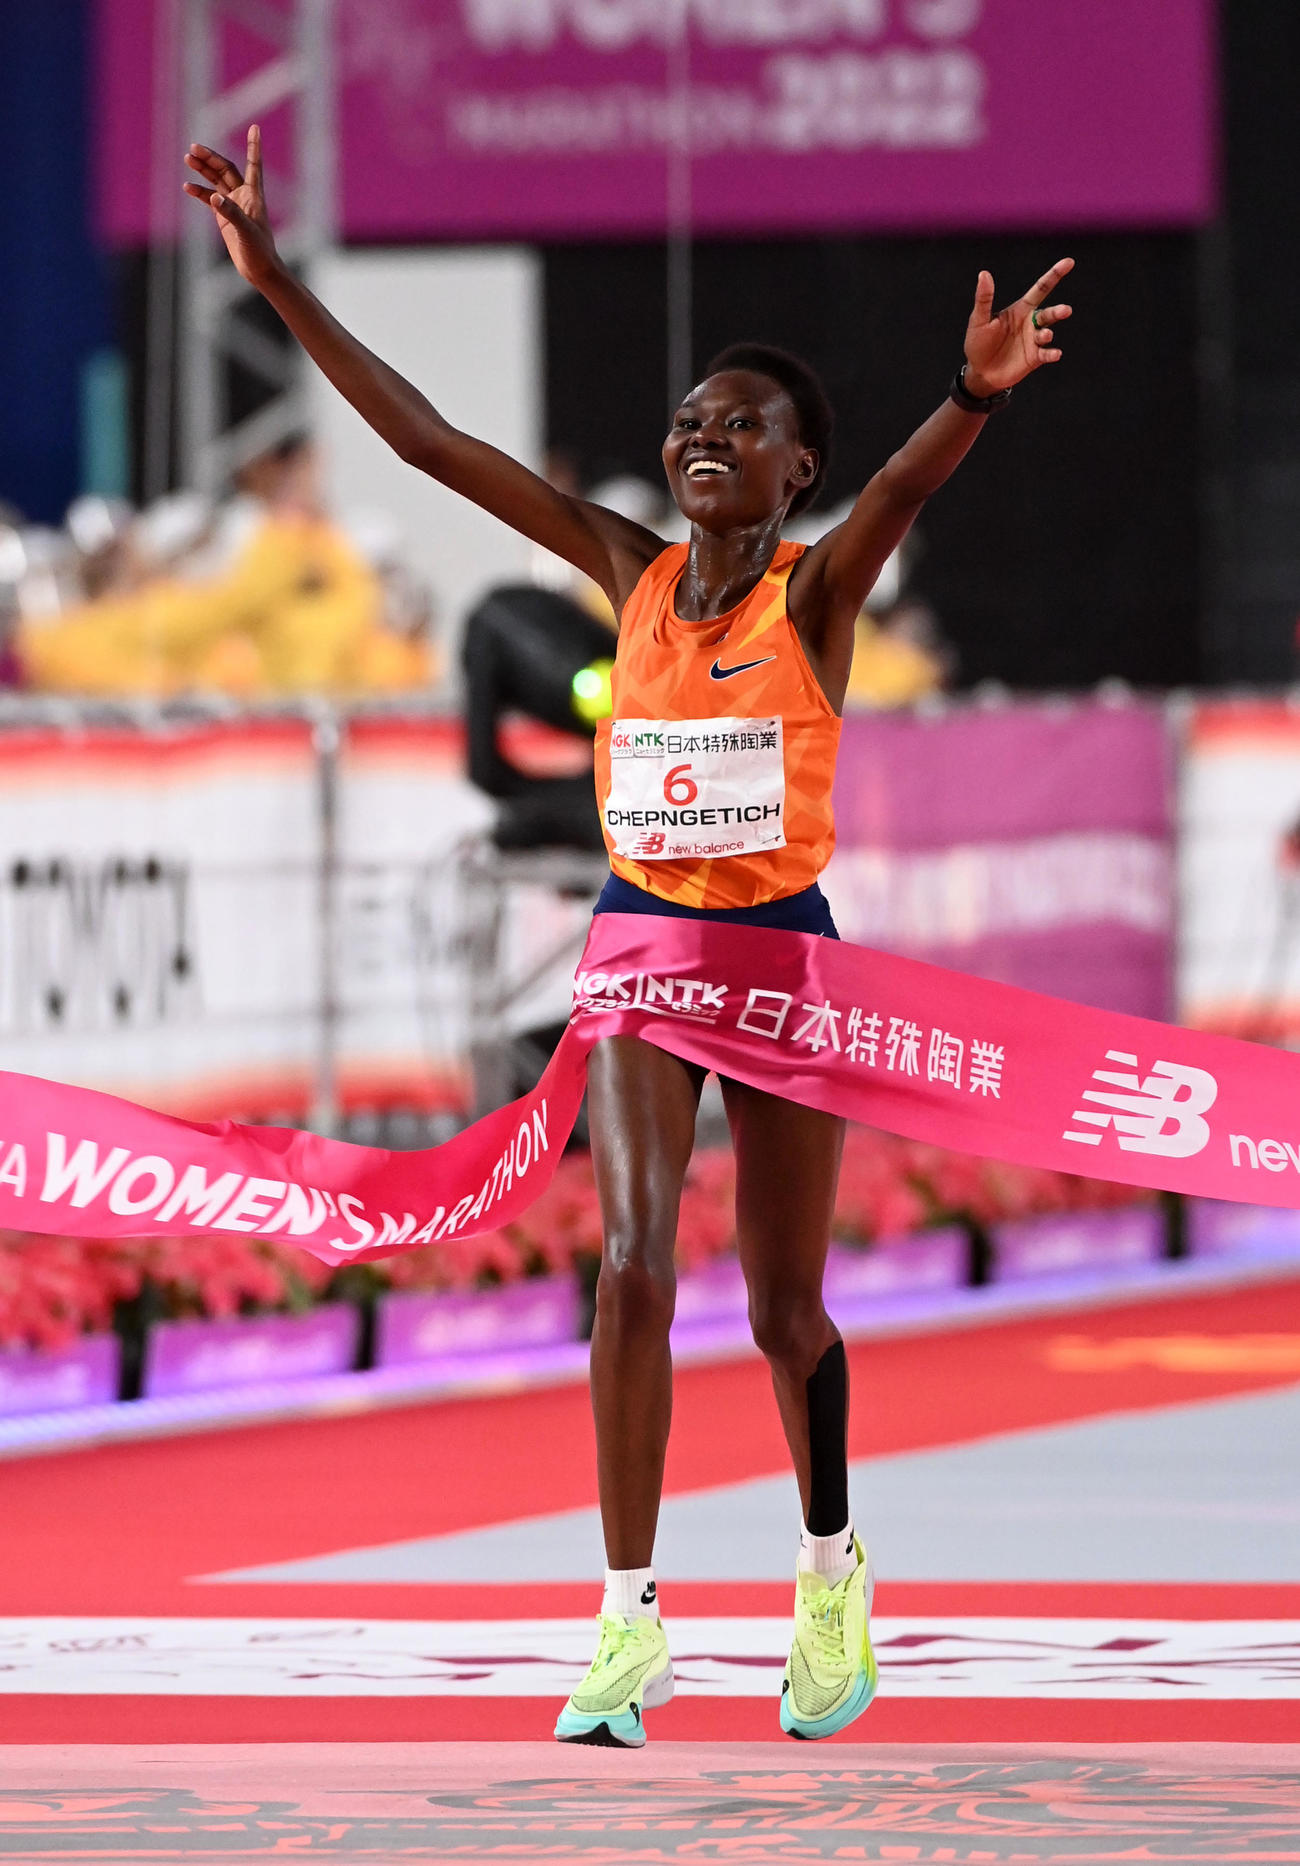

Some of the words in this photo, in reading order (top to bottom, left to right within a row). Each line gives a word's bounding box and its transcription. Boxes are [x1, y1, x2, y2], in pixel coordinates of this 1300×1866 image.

[635, 732, 665, 747] NTK
[667, 731, 778, 755] 日本特殊陶業
[664, 763, 698, 807] 6
[607, 803, 781, 827] CHEPNGETICH
[668, 844, 692, 855] new
[694, 840, 745, 854] balance
[644, 975, 729, 1009] NTK
[735, 987, 1006, 1099] 日本特殊陶業
[0, 1140, 27, 1197] A
[40, 1131, 375, 1251] WOMEN'S
[372, 1099, 549, 1247] MARATHON
